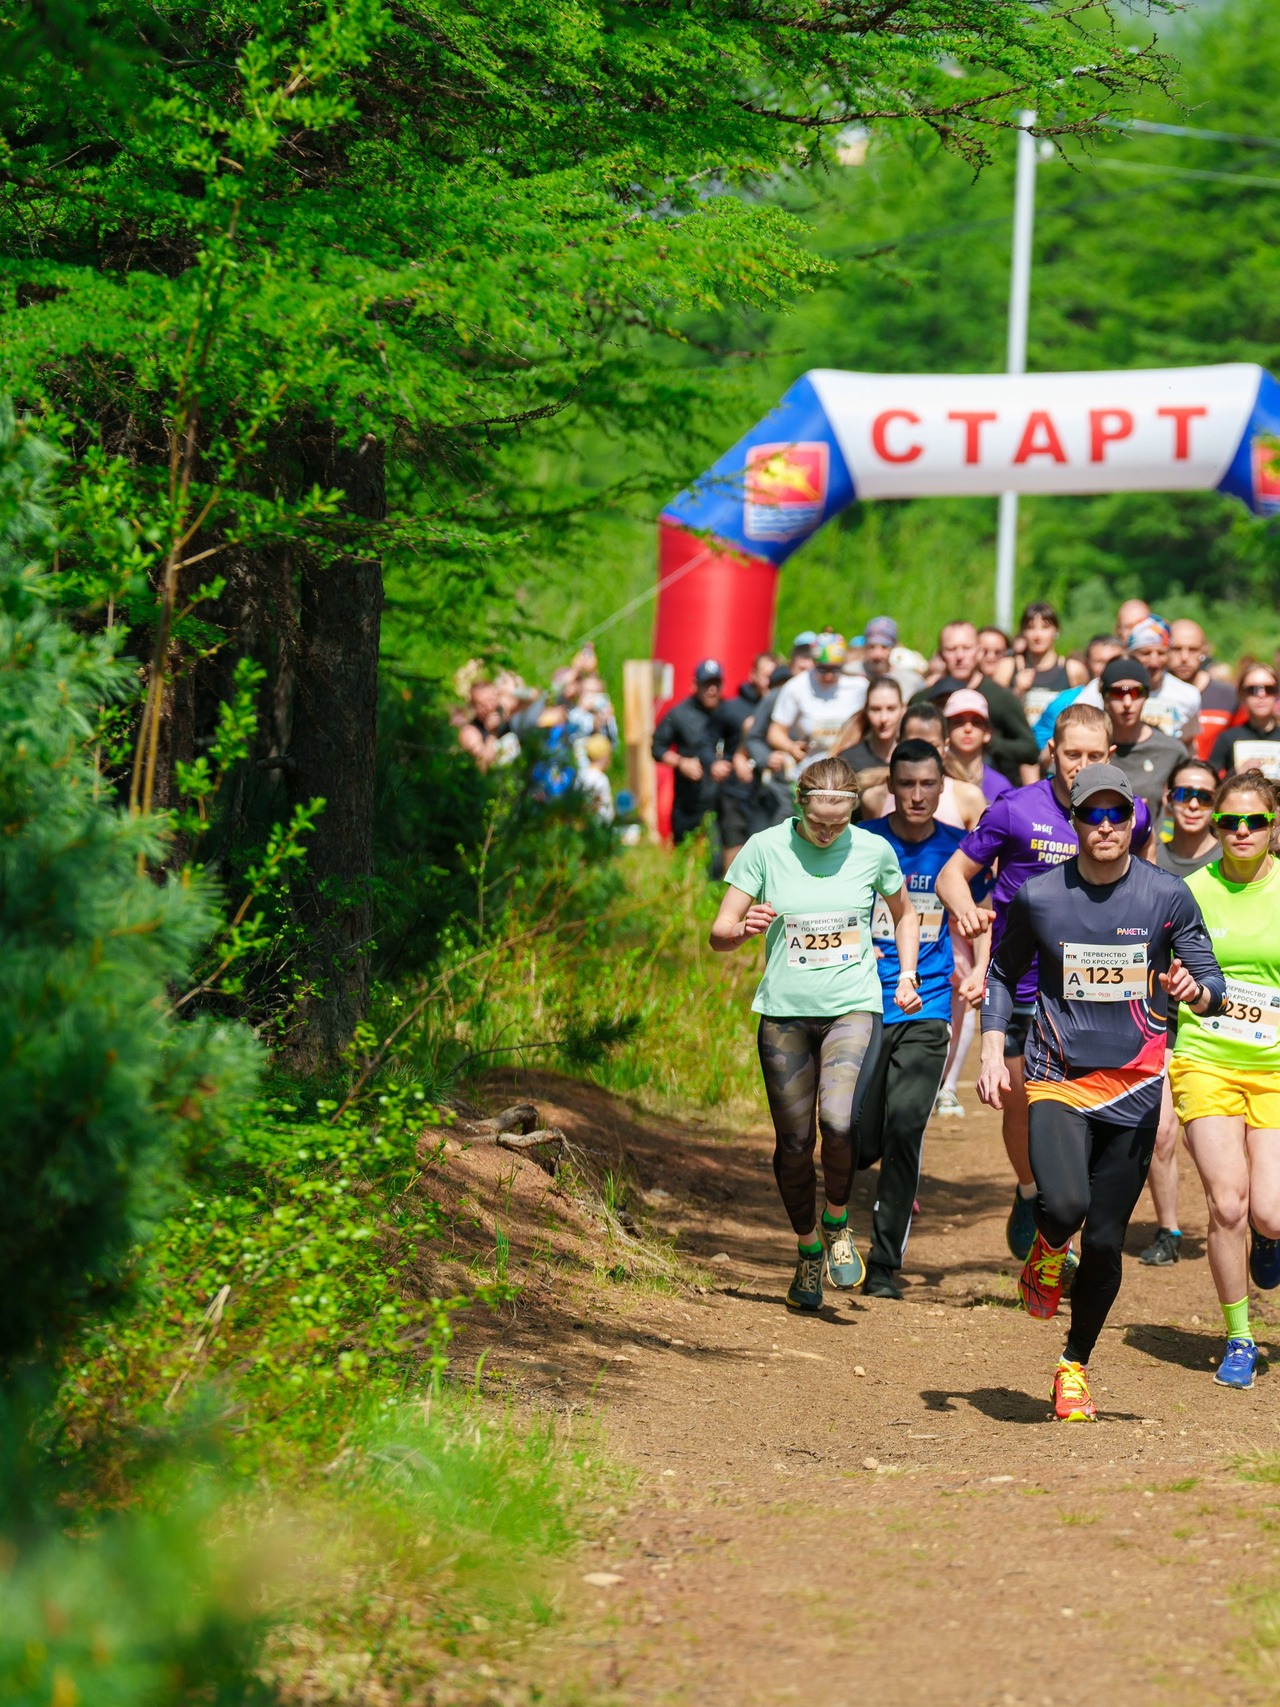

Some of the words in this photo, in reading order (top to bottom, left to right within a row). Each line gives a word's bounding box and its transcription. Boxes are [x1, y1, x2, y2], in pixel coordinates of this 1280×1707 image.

[871, 406, 1207, 465] СТАРТ
[1030, 839, 1077, 855] БЕГОВАЯ
[802, 918, 843, 926] ПЕРВЕНСТВО
[1116, 927, 1149, 936] РАКЕТЫ
[805, 931, 842, 950] 233
[1085, 966, 1124, 985] 123
[1233, 994, 1257, 1004] КРОССУ
[1225, 1000, 1262, 1023] 239
